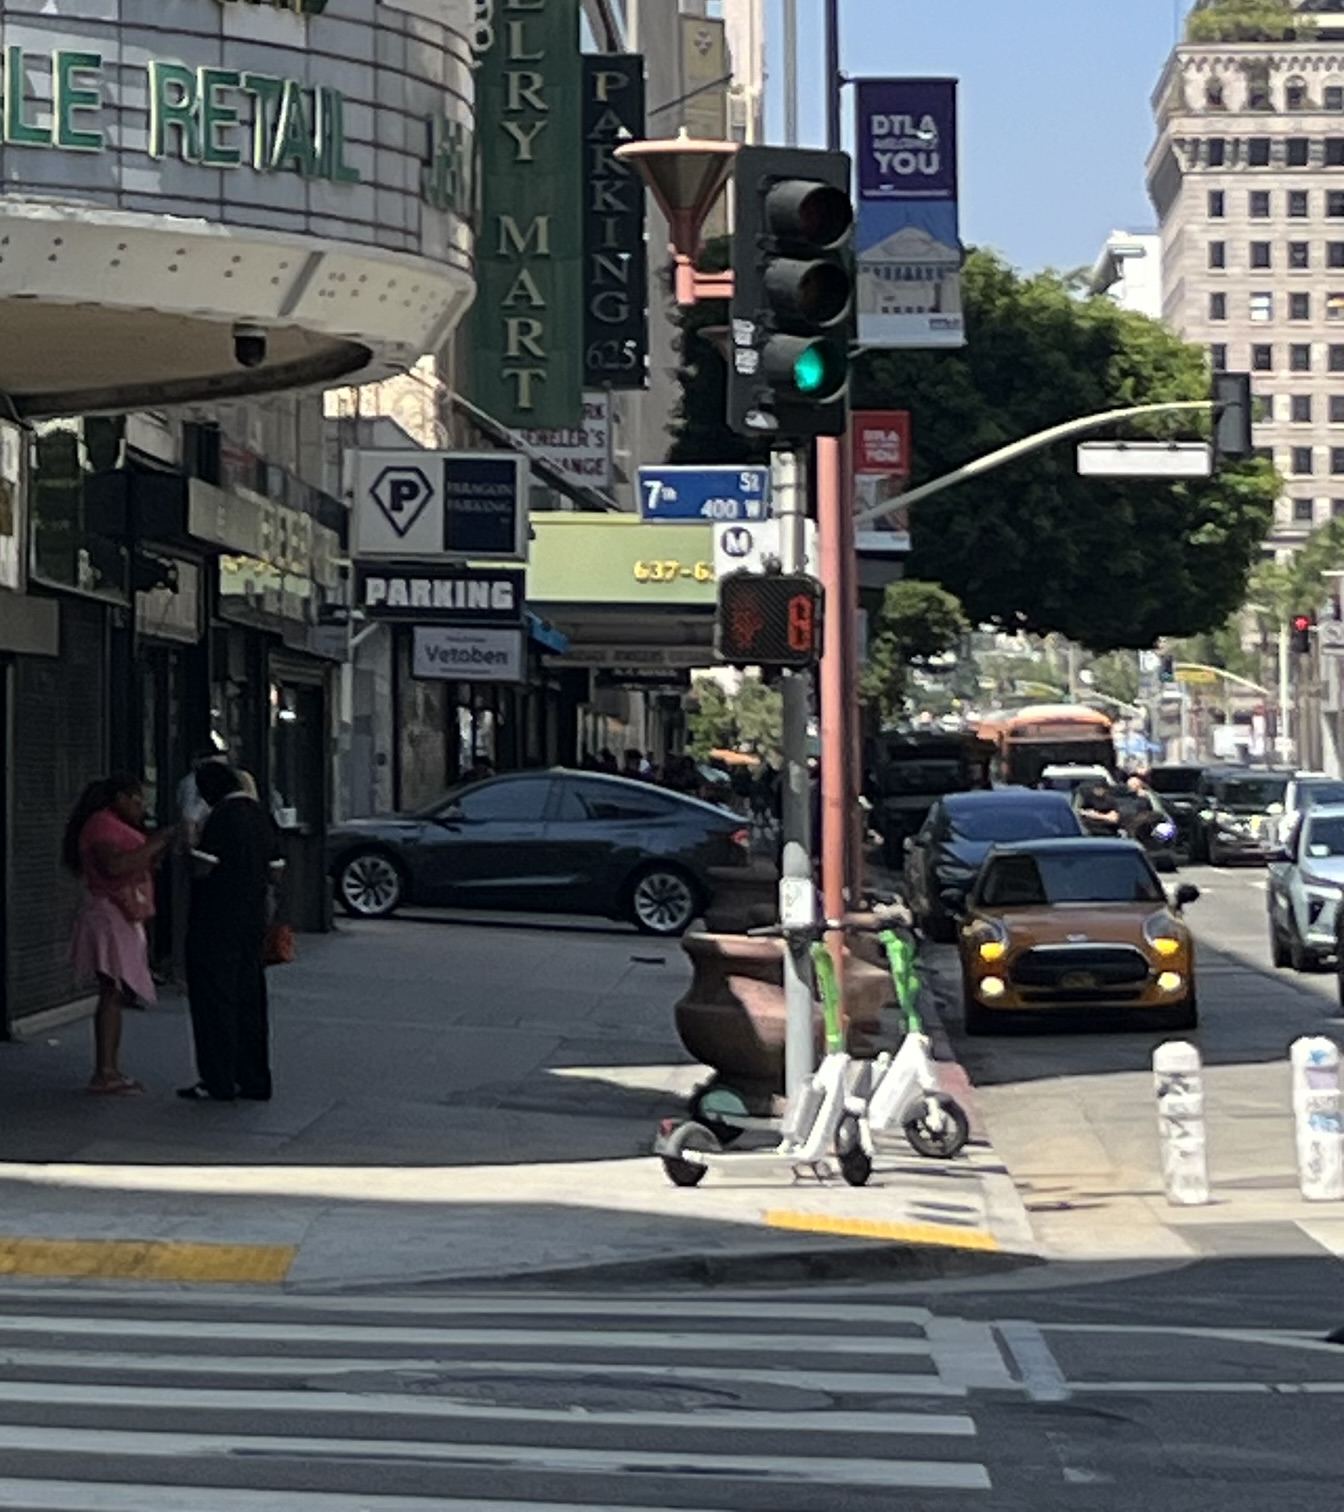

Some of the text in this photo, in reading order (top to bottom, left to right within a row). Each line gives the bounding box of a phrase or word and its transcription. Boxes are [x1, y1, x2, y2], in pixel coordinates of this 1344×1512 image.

[147, 60, 360, 183] RETAIL
[871, 114, 937, 136] DTLA
[873, 152, 940, 175] YOU
[587, 70, 632, 324] PARKING
[498, 215, 552, 410] MART
[701, 498, 738, 519] 400
[633, 559, 715, 583] 637-6
[365, 576, 514, 611] PARKING
